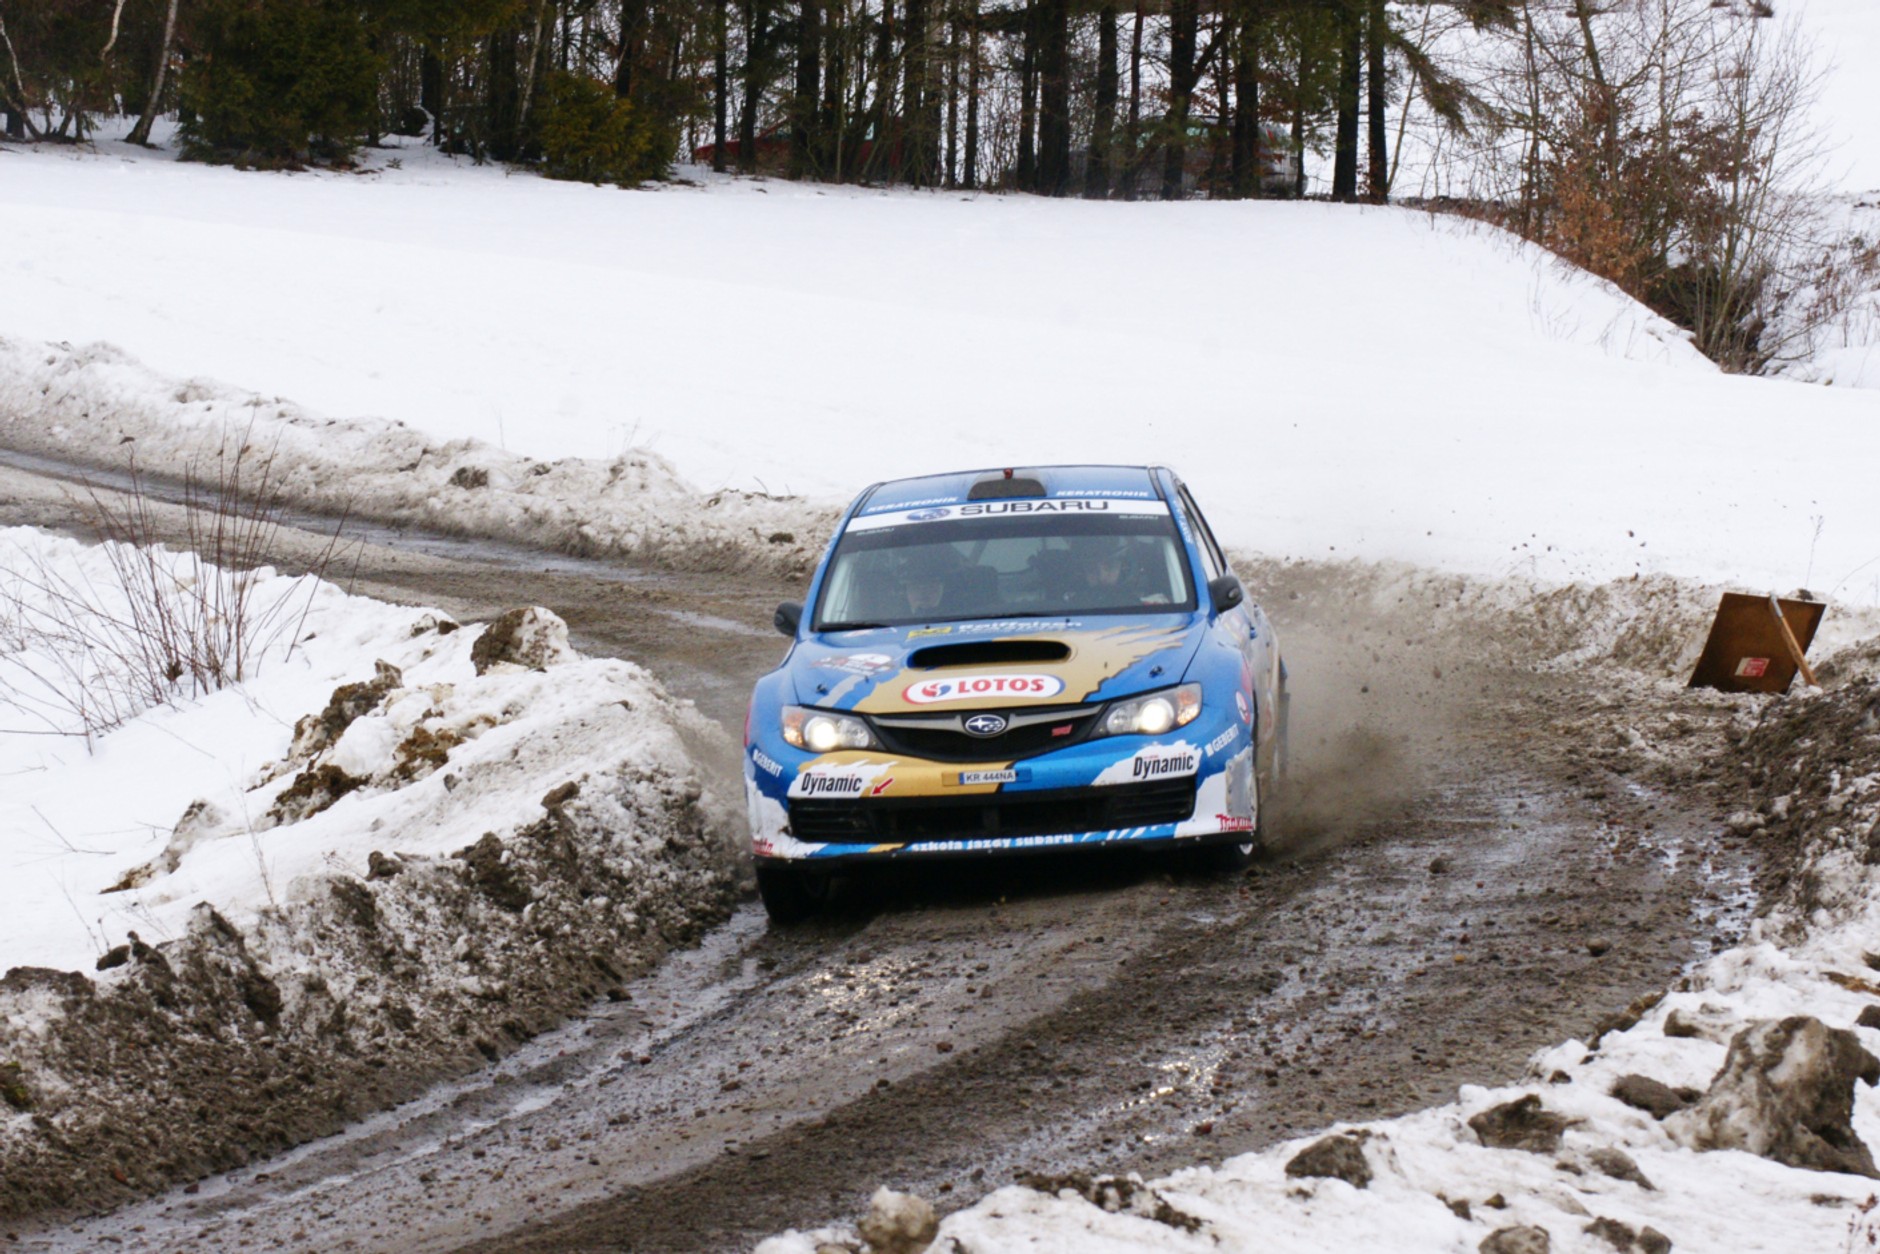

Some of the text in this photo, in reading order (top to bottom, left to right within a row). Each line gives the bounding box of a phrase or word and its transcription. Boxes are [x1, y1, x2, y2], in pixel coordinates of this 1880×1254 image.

[1056, 489, 1149, 498] KERATRONIK
[960, 501, 1109, 516] SUBARU
[958, 678, 1045, 694] LOTOS
[1132, 752, 1195, 779] Dynamic
[965, 770, 1014, 782] KR 444NA
[801, 772, 862, 796] Dynamic
